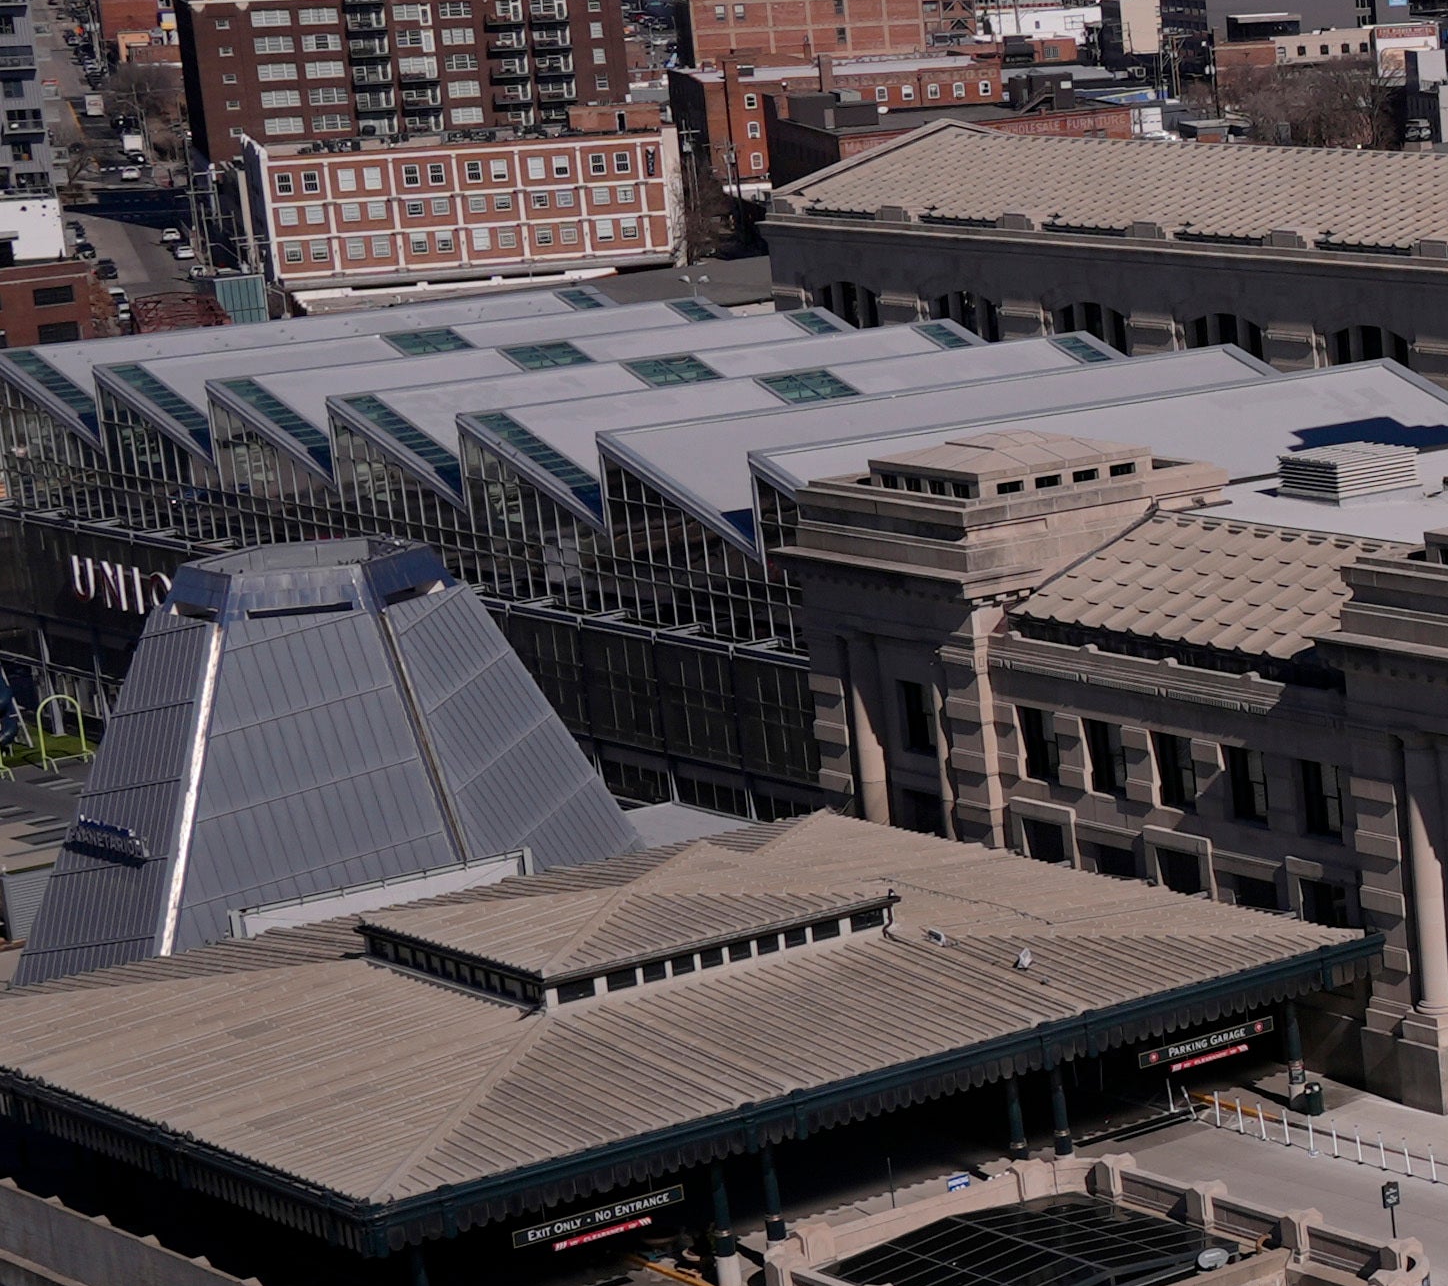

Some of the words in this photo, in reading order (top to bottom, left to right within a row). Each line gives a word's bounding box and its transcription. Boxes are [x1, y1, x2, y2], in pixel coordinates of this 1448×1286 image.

[70, 554, 172, 615] UNIO
[1168, 1038, 1208, 1058] PARKING
[1209, 1027, 1246, 1046] GARAGE
[527, 1226, 552, 1242] EXIT
[554, 1217, 583, 1234] ONLY
[595, 1211, 612, 1223] NO
[615, 1192, 670, 1217] ENTRANCE
[583, 1226, 625, 1243] CLEARANCE
